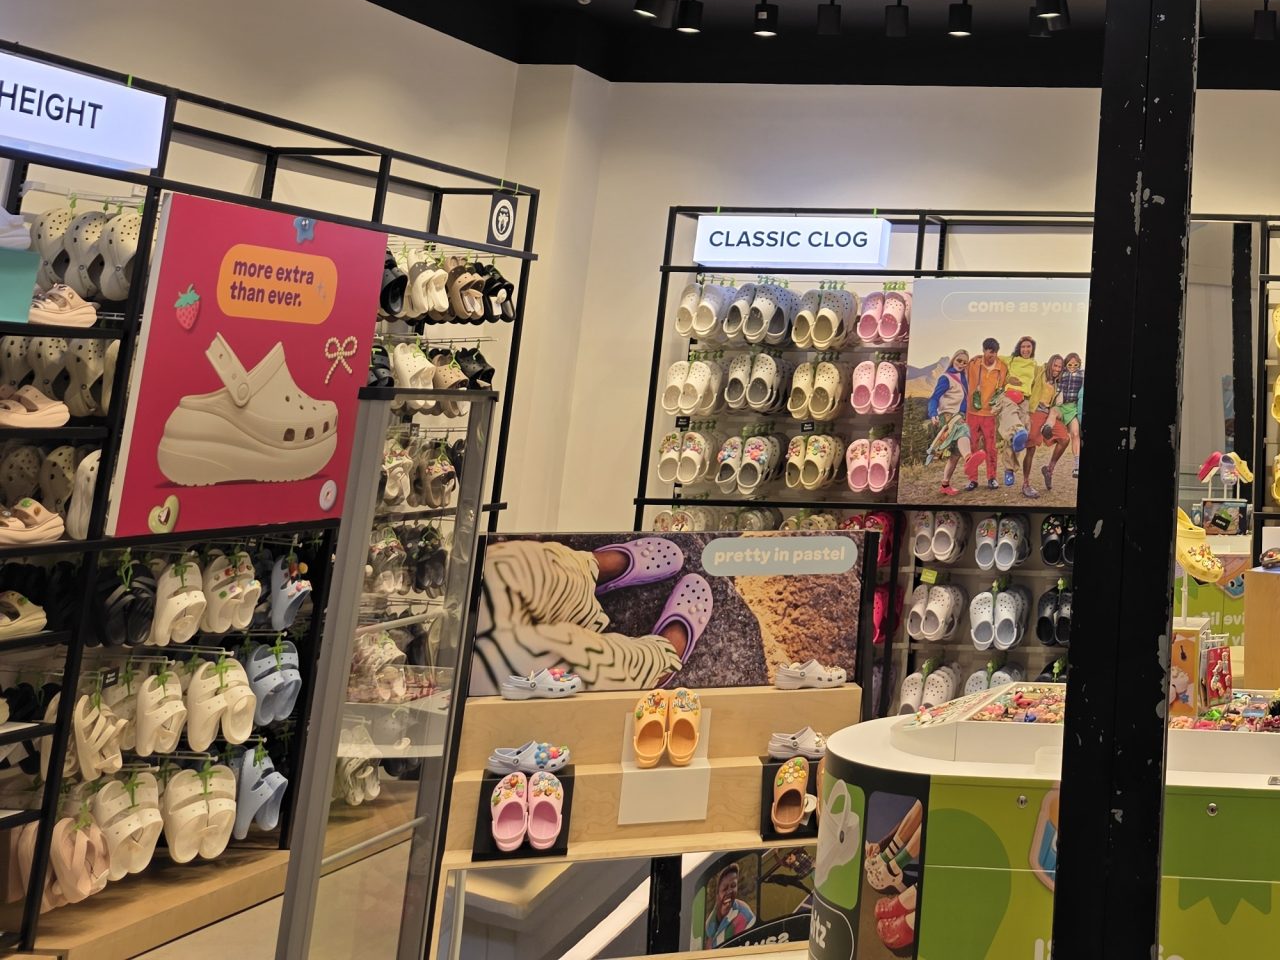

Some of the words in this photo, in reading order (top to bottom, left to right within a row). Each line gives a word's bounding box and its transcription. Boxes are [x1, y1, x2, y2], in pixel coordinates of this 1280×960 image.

[0, 80, 103, 129] HEIGHT
[709, 230, 801, 247] CLASSIC
[808, 231, 868, 248] CLOG
[233, 260, 273, 279] more
[276, 265, 314, 285] extra
[230, 281, 265, 303] than
[268, 289, 301, 307] ever.
[967, 301, 1015, 313] come
[1019, 302, 1038, 313] as
[1041, 302, 1073, 316] you
[714, 548, 770, 566] pretty
[773, 547, 788, 561] in
[792, 546, 845, 564] pastel
